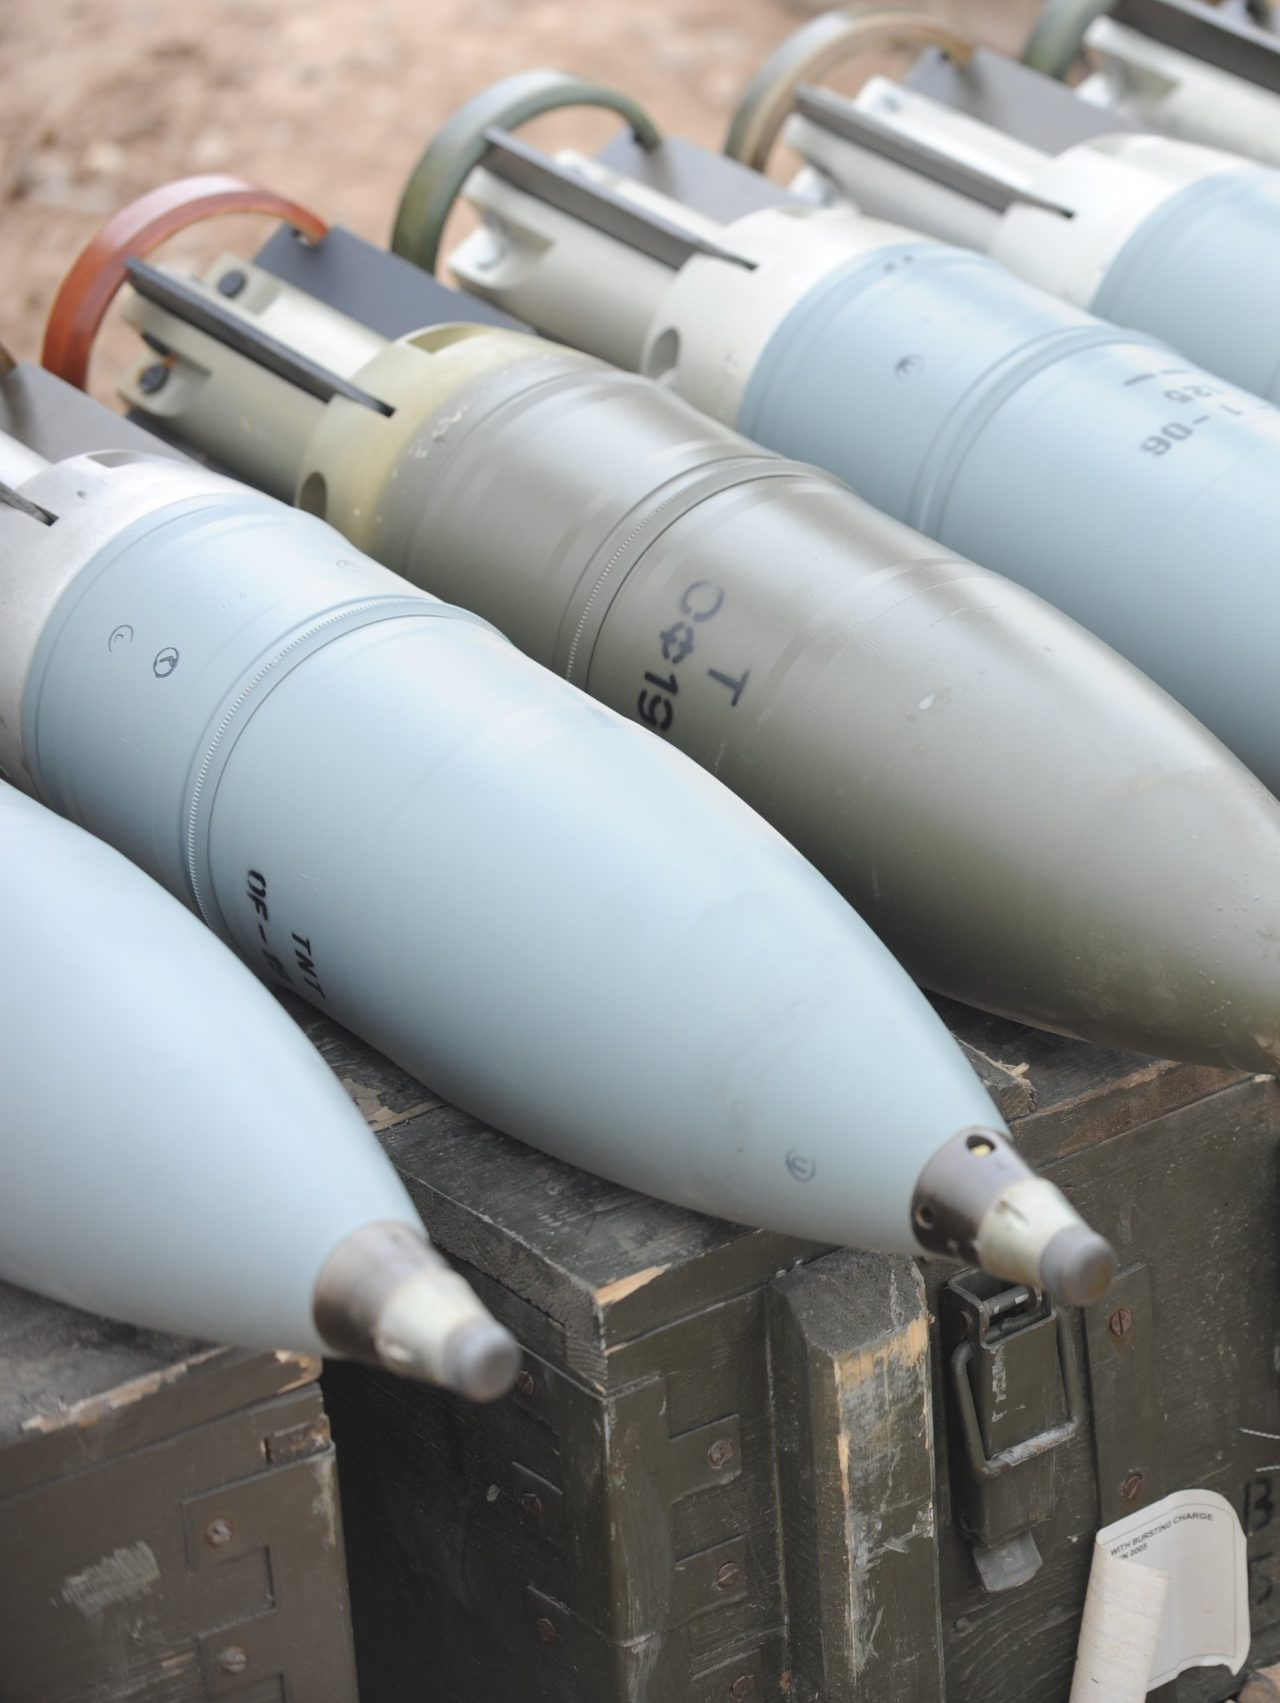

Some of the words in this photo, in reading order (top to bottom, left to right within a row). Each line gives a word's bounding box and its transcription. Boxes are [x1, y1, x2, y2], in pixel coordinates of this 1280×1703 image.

[291, 931, 327, 1000] TNT
[1110, 1540, 1132, 1556] WITH
[1131, 1520, 1173, 1547] BURSTING
[1172, 1511, 1214, 1525] CHARGE
